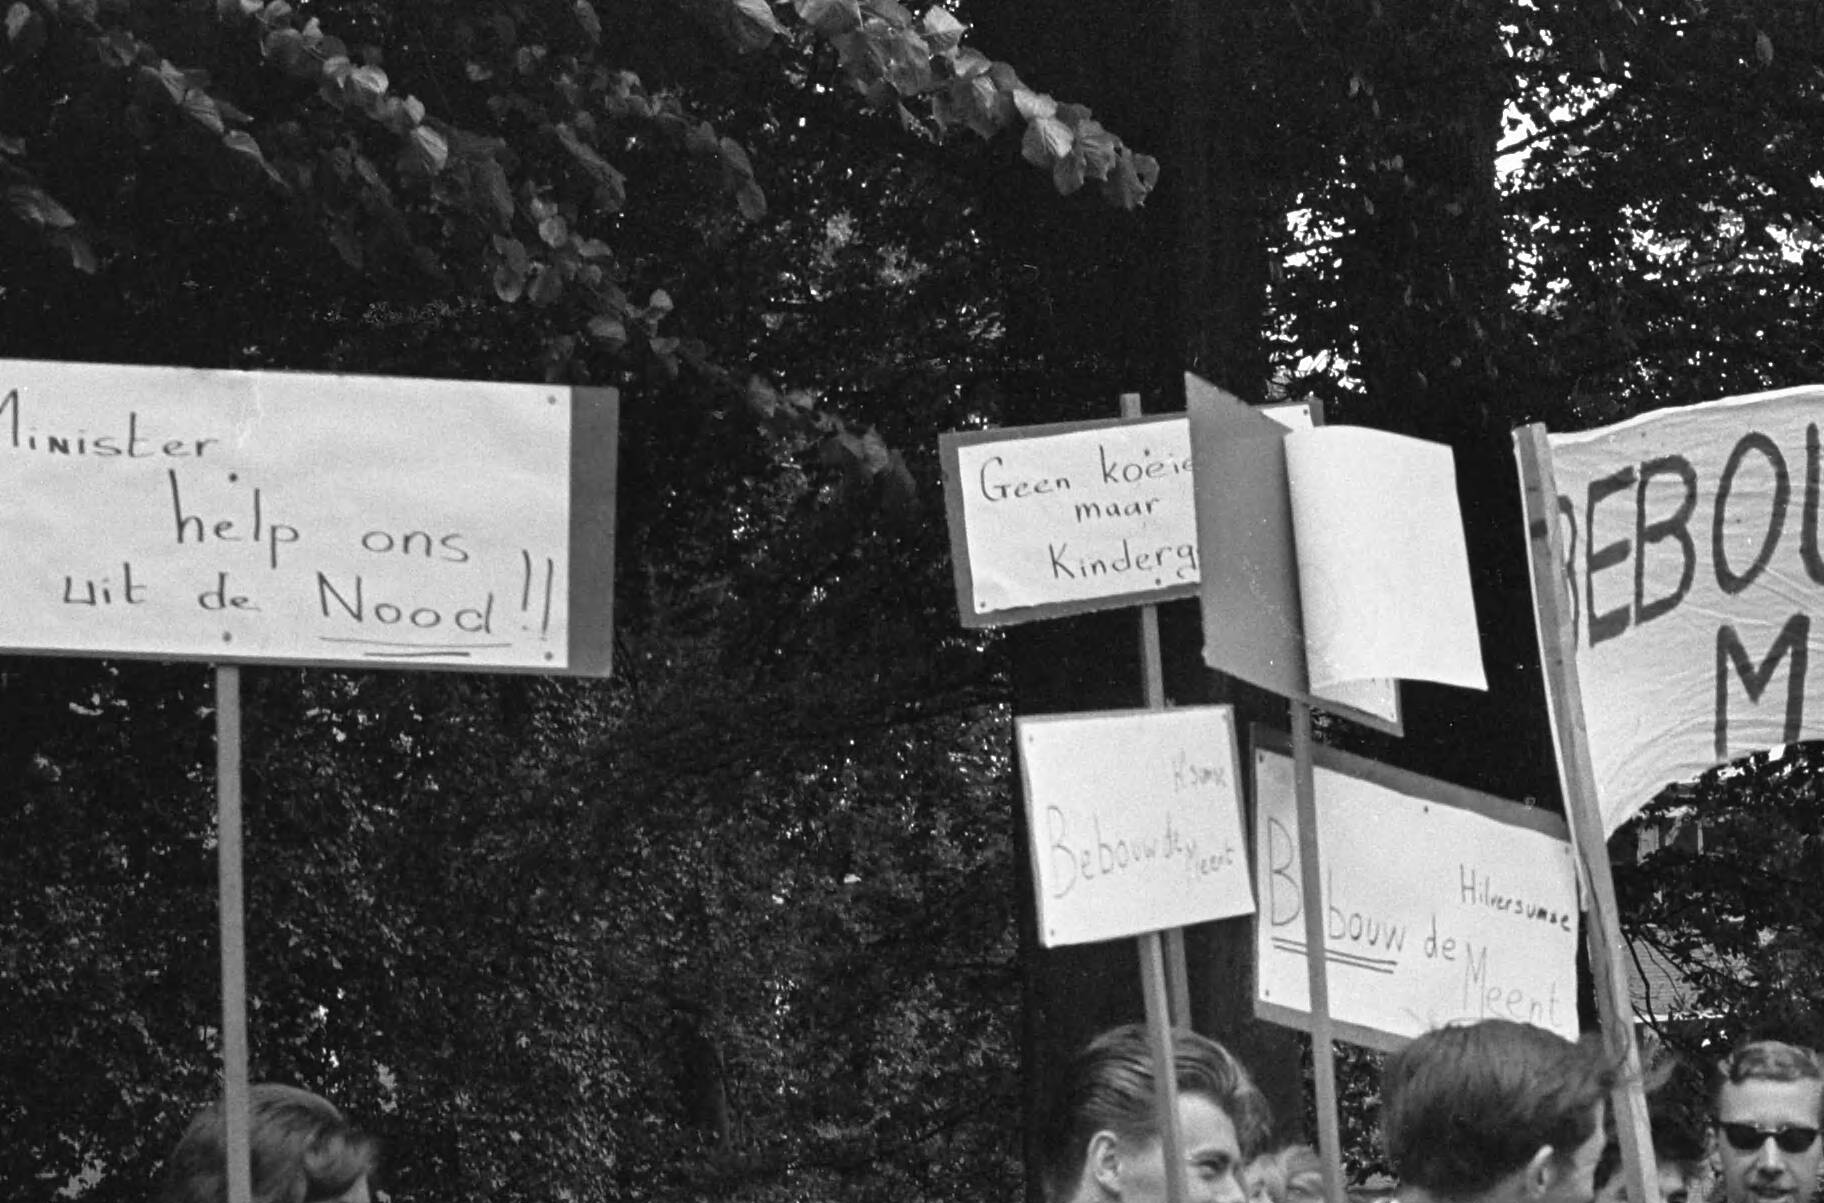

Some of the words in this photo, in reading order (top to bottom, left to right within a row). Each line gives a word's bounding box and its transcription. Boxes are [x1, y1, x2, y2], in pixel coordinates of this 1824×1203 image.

[980, 456, 1070, 502] Geen
[168, 468, 299, 569] help
[360, 531, 468, 562] ons
[1075, 497, 1160, 523] maar
[1049, 538, 1199, 580] Kinderg
[198, 571, 261, 611] de
[1268, 816, 1406, 952] Bbouw
[1424, 914, 1456, 961] de
[1459, 863, 1571, 932] Hilversumse
[1462, 941, 1560, 1026] Meent
